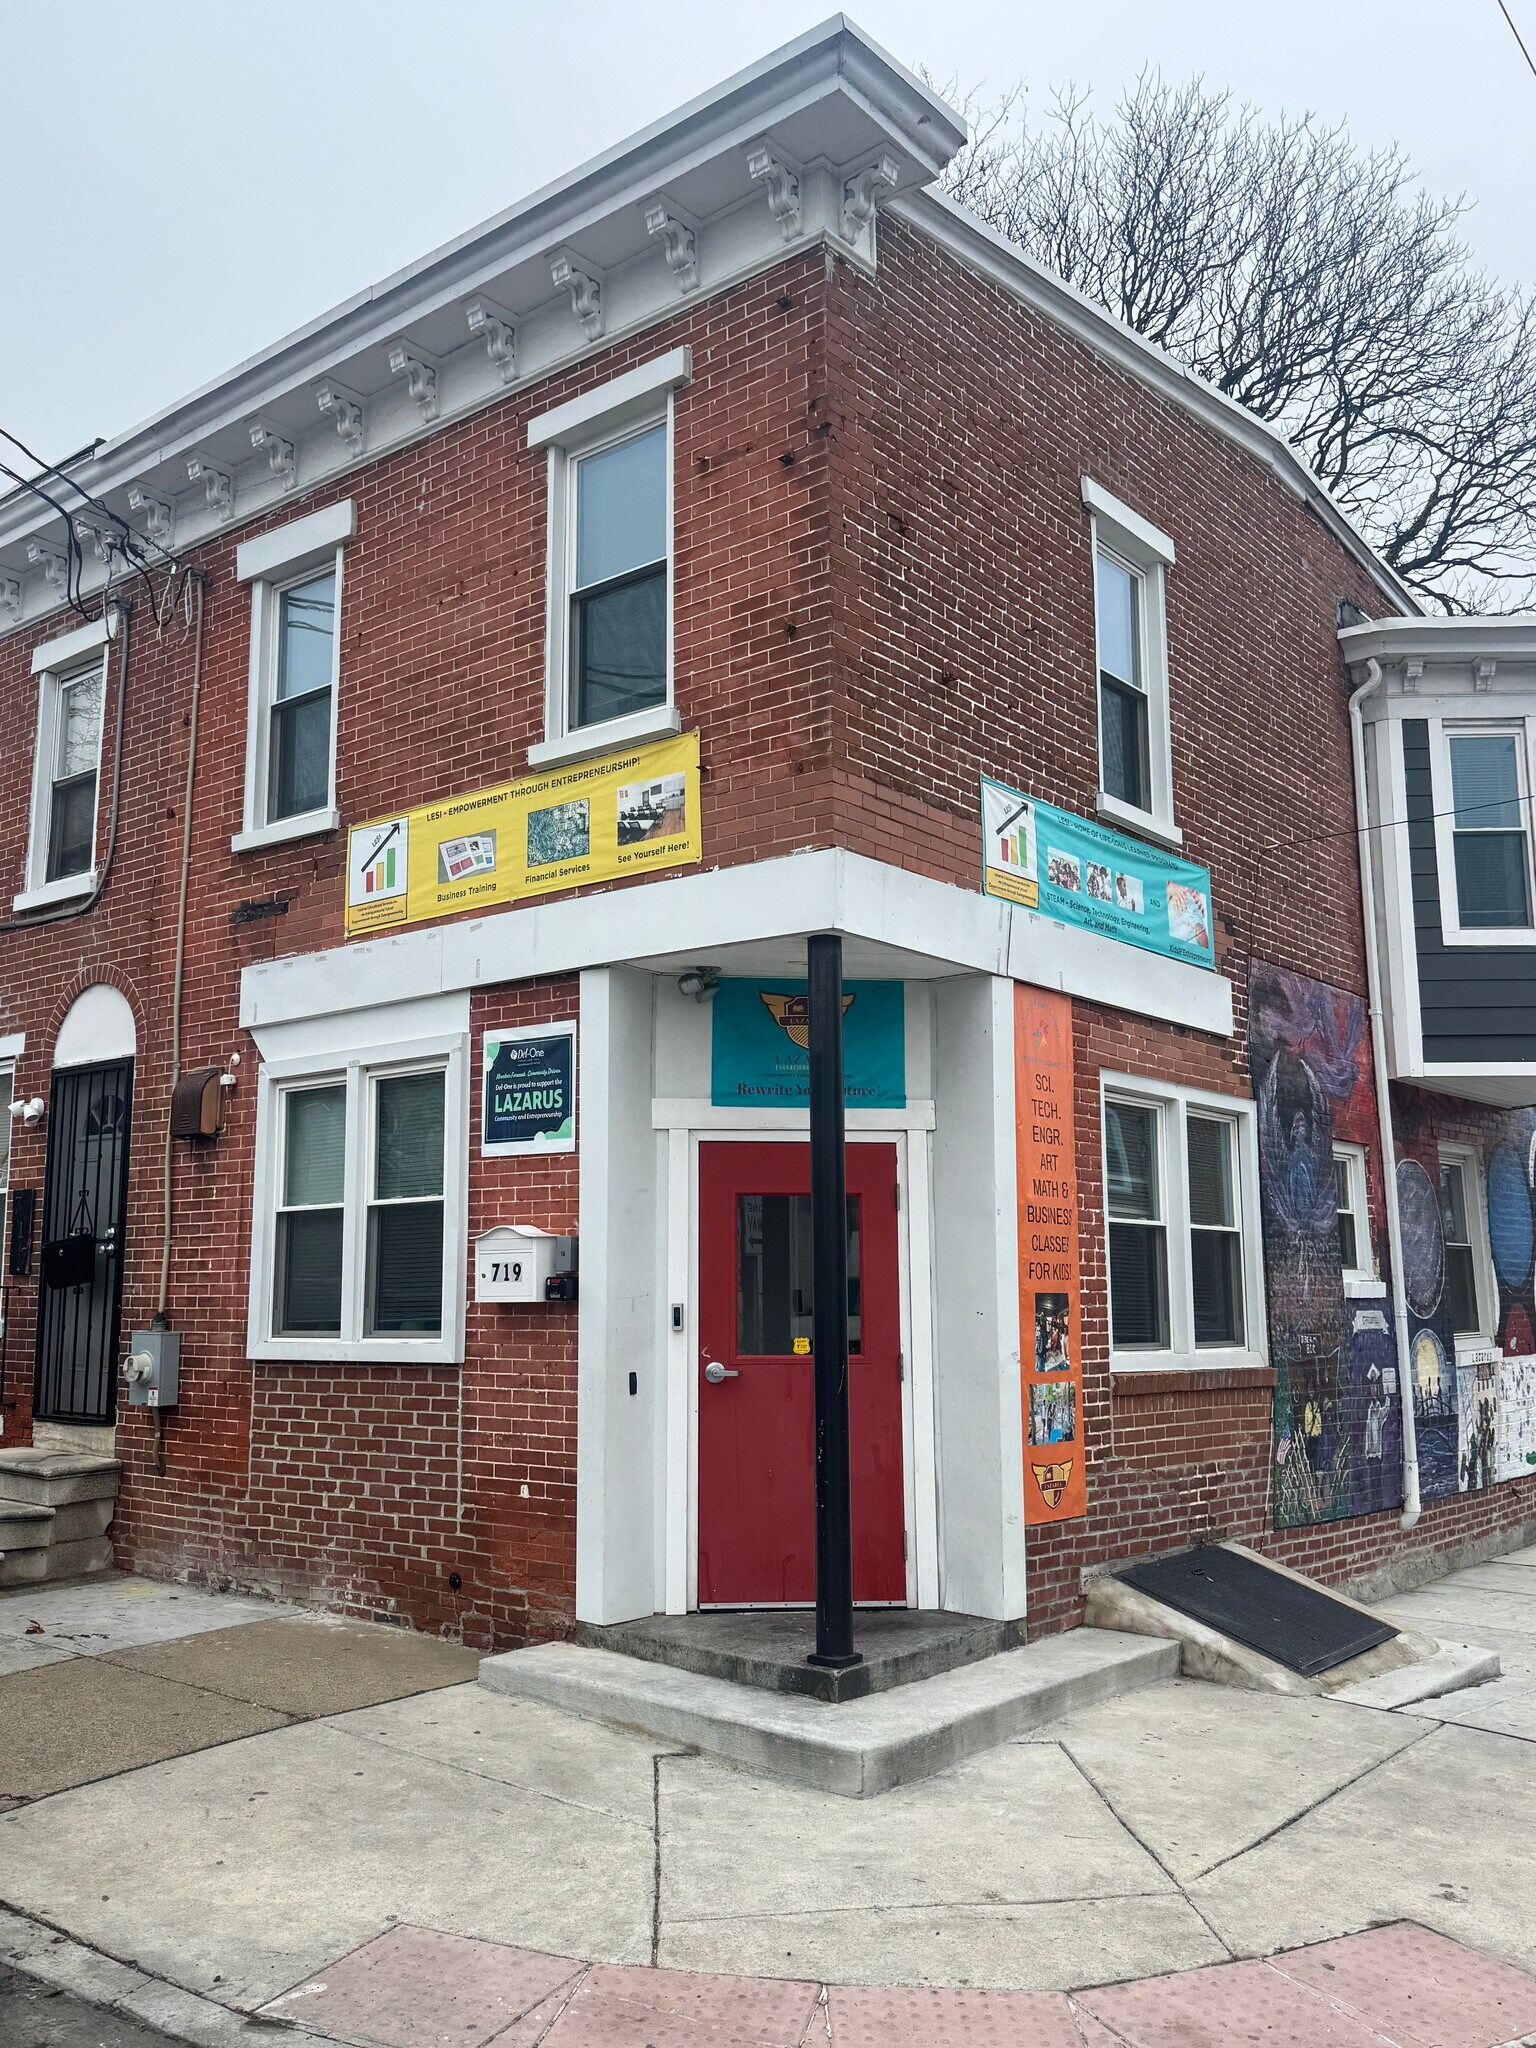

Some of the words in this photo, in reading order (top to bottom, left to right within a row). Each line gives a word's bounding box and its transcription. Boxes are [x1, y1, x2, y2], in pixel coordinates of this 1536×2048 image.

[427, 811, 442, 822] LESI
[448, 792, 508, 816] EMPOWERMENT
[510, 781, 549, 800] THROUGH
[551, 756, 641, 788] ENTREPRENEURSHIP!
[617, 854, 632, 864] See
[633, 845, 666, 860] Yourself
[667, 840, 690, 852] Here!
[525, 868, 558, 884] Financial
[559, 863, 590, 879] Services
[437, 889, 467, 902] Business
[468, 882, 497, 896] Training
[1150, 898, 1161, 908] AND
[1046, 892, 1065, 906] STEAM
[1069, 900, 1091, 915] Science,
[1092, 908, 1121, 925] Technology,
[1121, 917, 1150, 935] Engineering,
[1094, 920, 1105, 930] and
[1105, 923, 1118, 934] Math
[517, 1047, 545, 1060] Del-One
[517, 1081, 531, 1089] proud
[536, 1080, 555, 1088] support
[737, 1083, 793, 1096] Rewrite
[1035, 1073, 1055, 1093] SCI.
[494, 1088, 563, 1113] LAZARUS
[1031, 1098, 1062, 1120] TECH.
[527, 1111, 563, 1120] Entrepreneurship
[1032, 1125, 1064, 1146] ENGR.
[1040, 1152, 1059, 1172] ART
[1032, 1178, 1059, 1198] MATH
[1061, 1181, 1069, 1199] &
[1027, 1205, 1073, 1226] BUSINESS
[491, 1262, 522, 1282] 719
[1028, 1261, 1051, 1280] FOR
[1053, 1263, 1072, 1281] KIDS!
